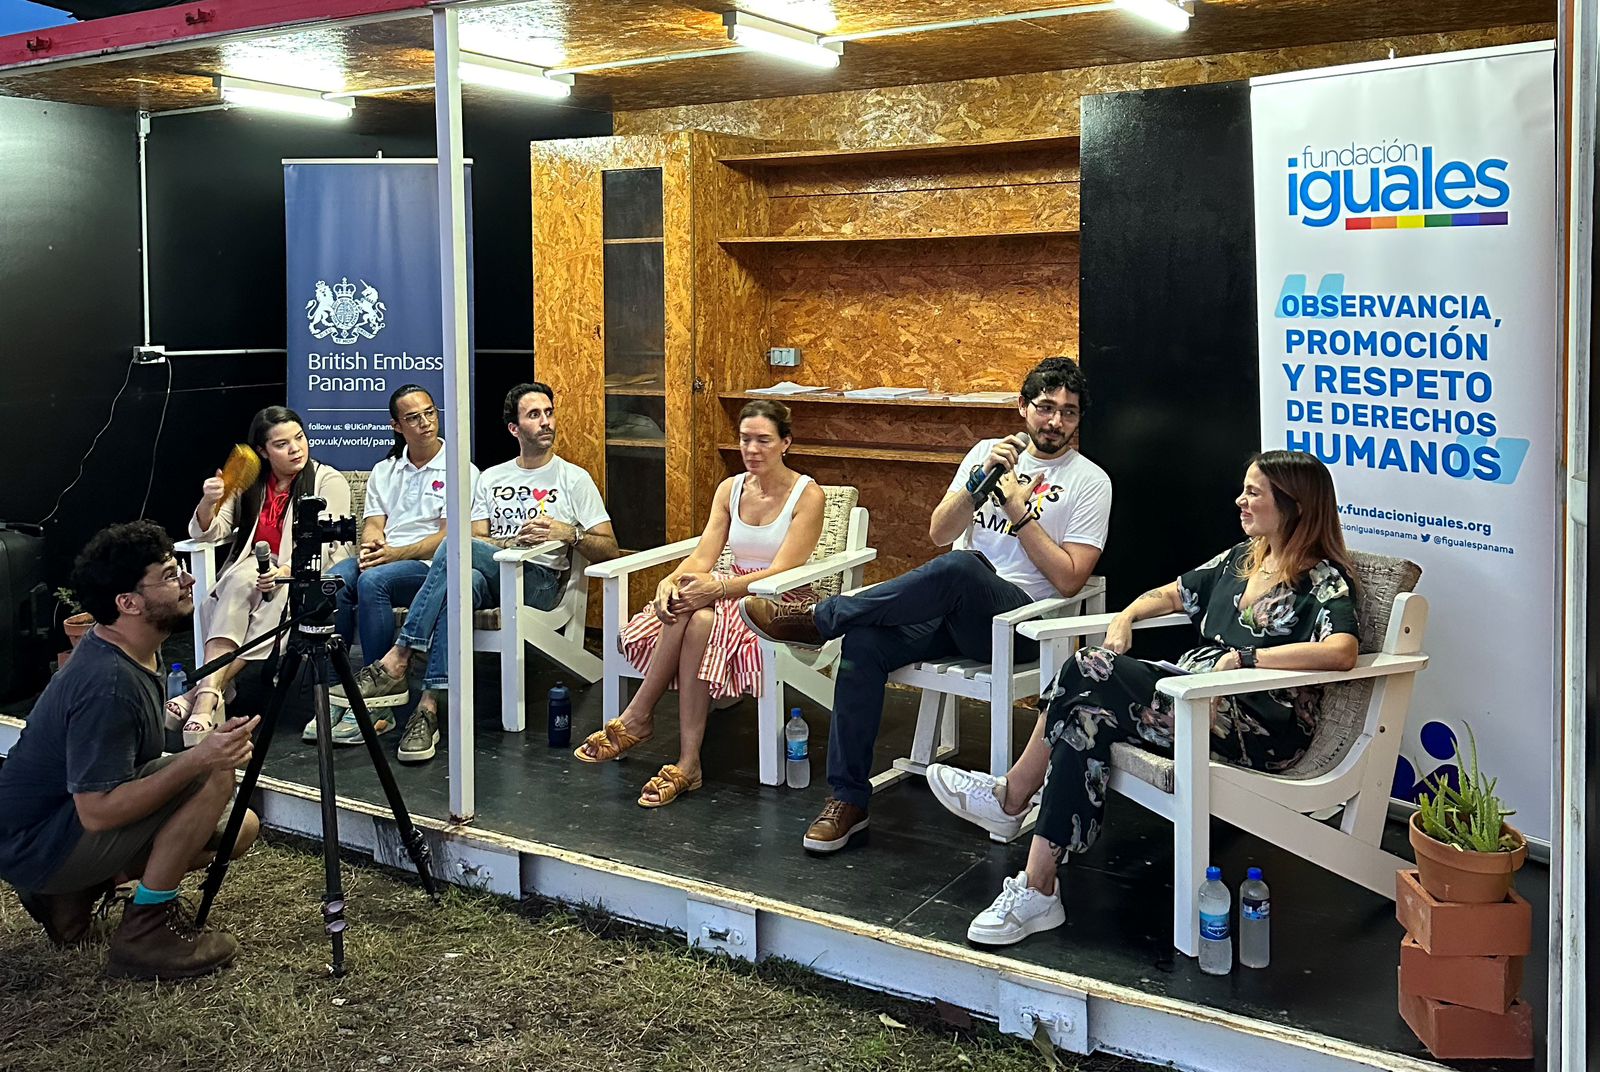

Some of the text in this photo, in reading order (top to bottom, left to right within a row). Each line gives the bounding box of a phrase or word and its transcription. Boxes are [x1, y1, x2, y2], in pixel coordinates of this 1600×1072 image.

[1302, 138, 1418, 169] fundación
[1287, 146, 1510, 228] iguales
[1281, 294, 1502, 328] OBSERVANCIA,
[1285, 325, 1488, 361] PROMOCIÓN
[308, 352, 444, 371] British Embass
[308, 374, 386, 391] Panama
[1282, 363, 1492, 403] Y RESPETO
[308, 422, 395, 431] follow us: @UKinPanam
[1287, 400, 1497, 437] DE DERECHOS
[308, 436, 396, 448] gov.uk/world/pana
[1286, 430, 1502, 481] HUMANOS
[1337, 503, 1492, 536] w.fundacioniguales.org
[1433, 535, 1514, 555] @figualespanama
